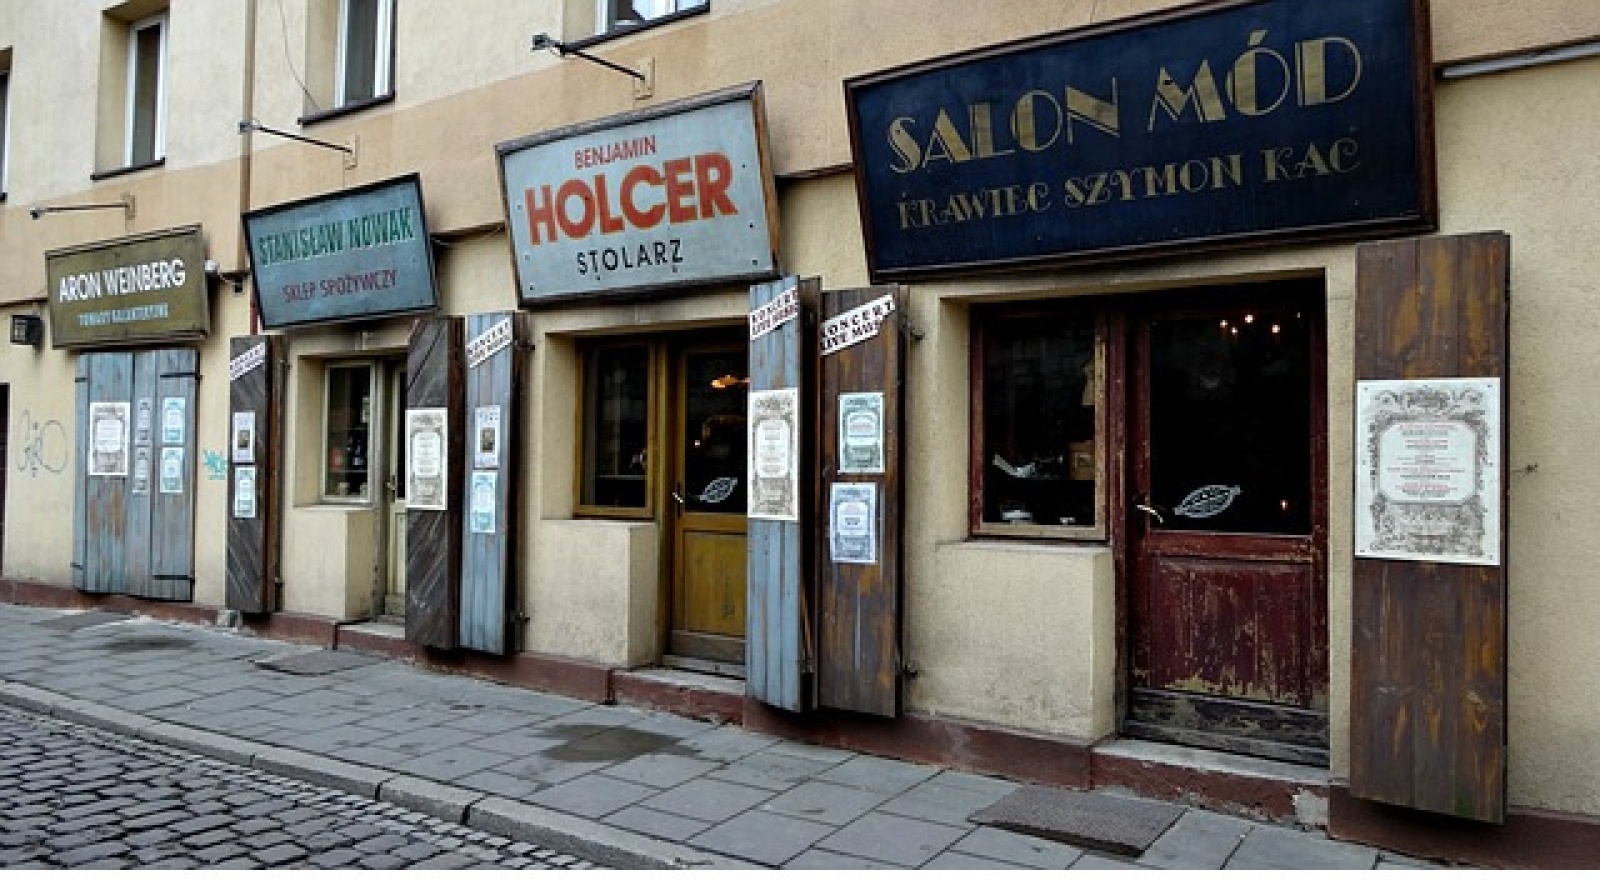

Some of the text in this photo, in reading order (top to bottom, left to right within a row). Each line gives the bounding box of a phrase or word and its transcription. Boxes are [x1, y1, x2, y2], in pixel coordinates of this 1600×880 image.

[887, 29, 1363, 173] SALON MÓD
[574, 135, 656, 170] BENJAMIN
[524, 152, 739, 246] HOLCER
[897, 182, 1051, 229] KRAWIEC
[1064, 154, 1242, 208] SZYMON
[259, 207, 416, 267] STANISŁAW NOWAK
[577, 239, 683, 276] STOLARZ
[59, 257, 186, 302] ARON WEINBERG
[282, 281, 316, 303] SKLEP
